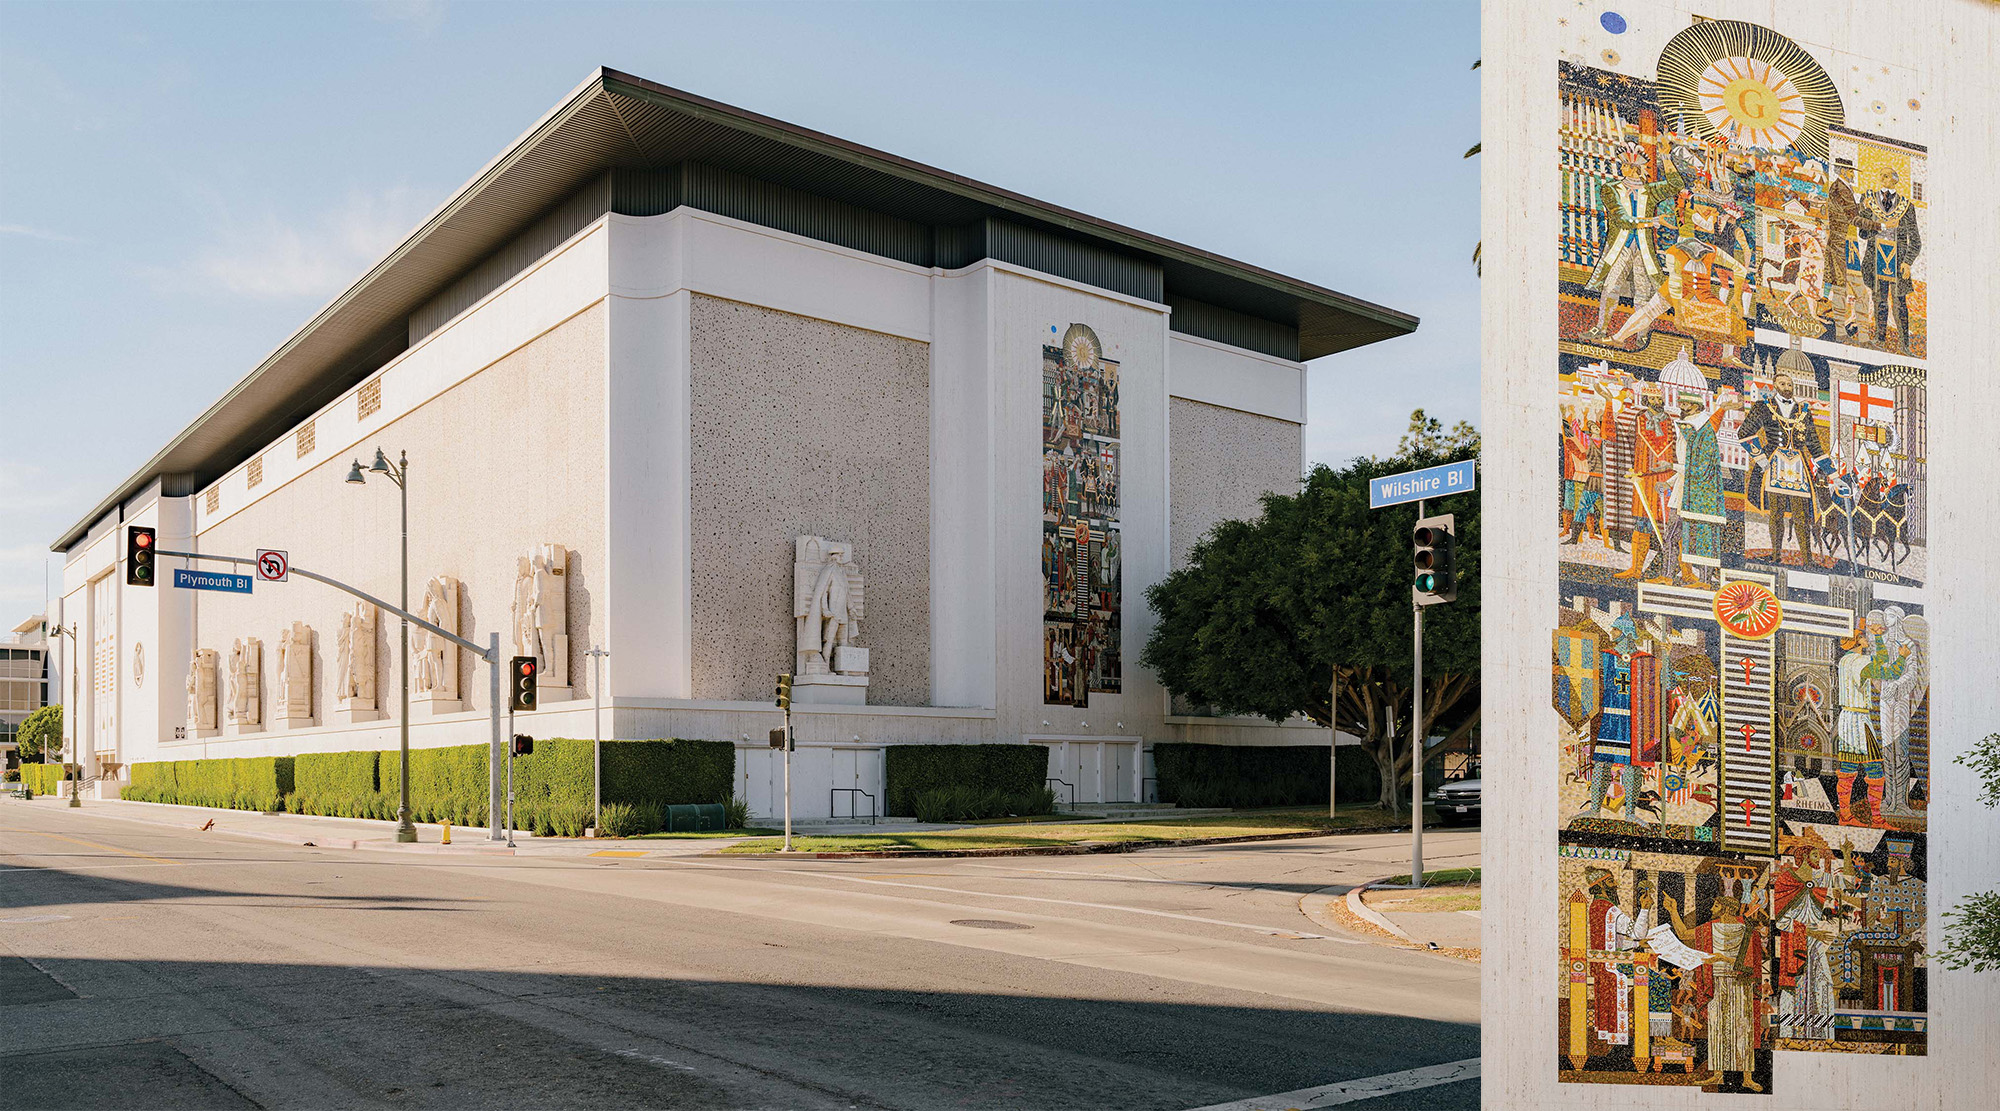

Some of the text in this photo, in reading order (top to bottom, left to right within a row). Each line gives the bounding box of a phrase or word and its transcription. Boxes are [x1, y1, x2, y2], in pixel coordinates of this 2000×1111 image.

[1738, 89, 1764, 119] G
[1761, 312, 1821, 333] SACRAMENTO
[1576, 343, 1614, 358] BOSTON
[1381, 469, 1463, 499] Wilshire Bl
[180, 573, 247, 589] Plymouth Bl
[1864, 570, 1899, 583] LONDON
[1796, 799, 1831, 811] RHEIMS
